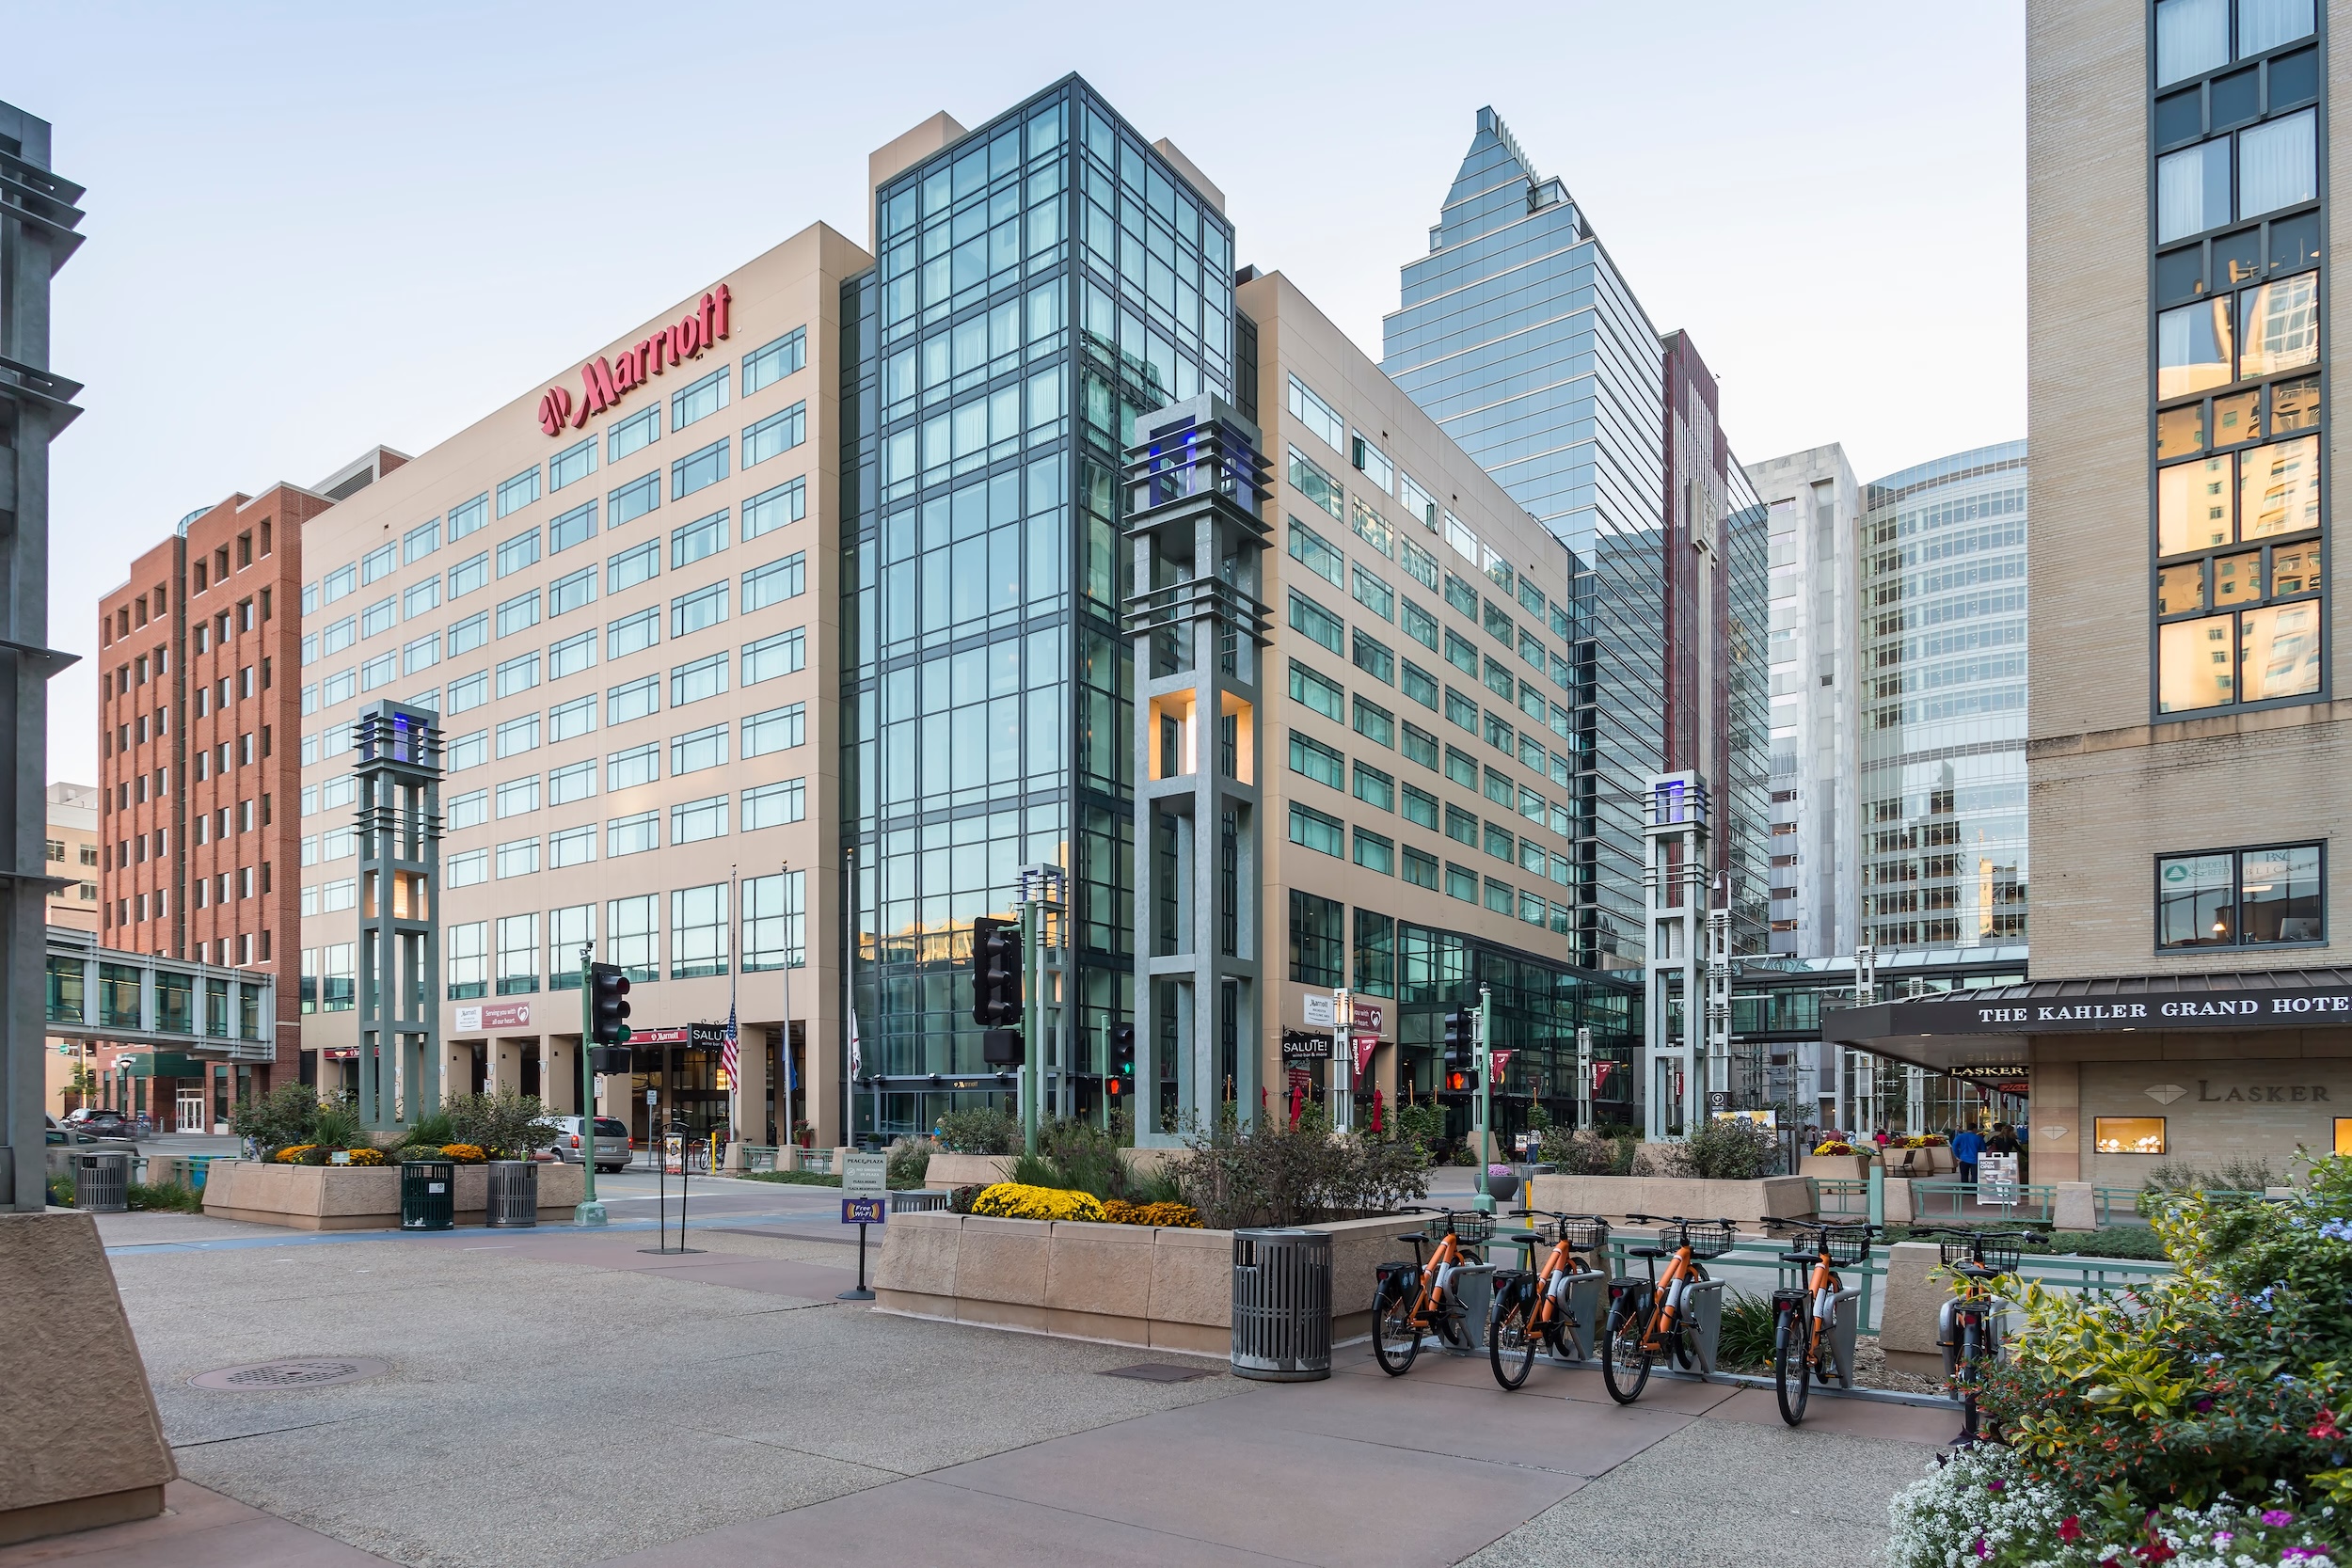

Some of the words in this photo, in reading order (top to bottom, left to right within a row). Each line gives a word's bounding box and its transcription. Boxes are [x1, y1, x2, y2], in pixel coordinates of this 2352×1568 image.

[571, 283, 732, 429] Marriott
[2265, 850, 2295, 863] B&C
[2187, 861, 2229, 870] WADDELL
[1979, 1008, 2027, 1022] THE
[2038, 1004, 2148, 1021] KAHLER
[2161, 1000, 2258, 1017] GRAND
[2272, 996, 2352, 1013] HOTE
[656, 1032, 679, 1041] Marriott
[692, 1029, 727, 1040] SALUT
[1284, 1039, 1327, 1053] SALUTE!
[1353, 1038, 1361, 1075] peaceplaza
[1950, 1067, 2028, 1075] LASKER
